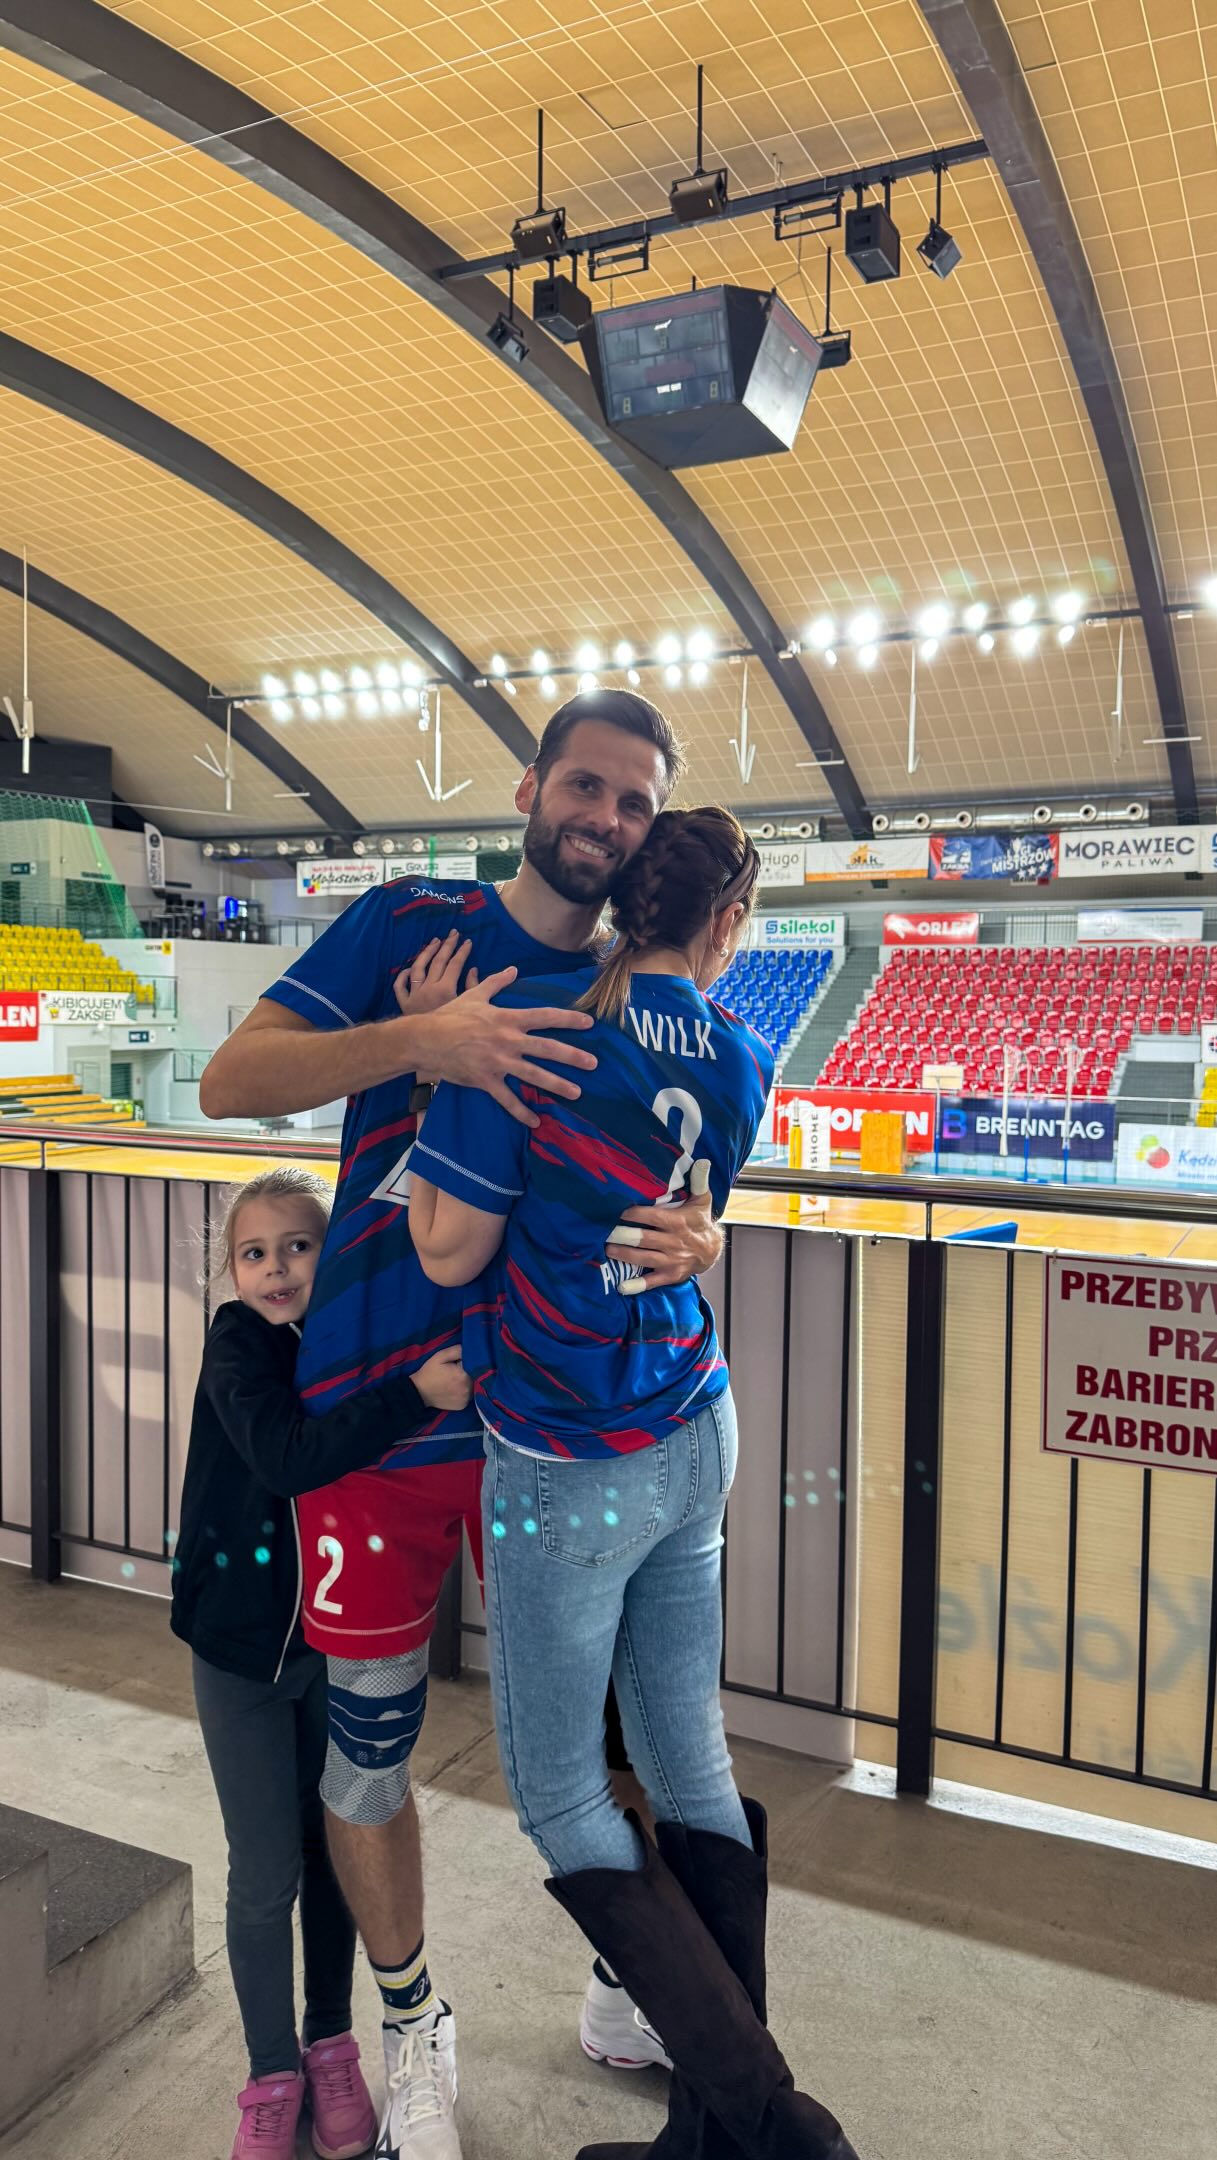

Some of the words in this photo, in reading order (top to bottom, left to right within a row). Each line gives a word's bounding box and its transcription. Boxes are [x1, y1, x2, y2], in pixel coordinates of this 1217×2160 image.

[762, 852, 800, 868] Hugo
[1065, 837, 1195, 860] MORAWIEC
[1101, 857, 1174, 869] PALIWA
[767, 936, 803, 944] Solutions
[819, 937, 834, 945] you
[780, 919, 835, 934] silekol
[628, 1006, 717, 1061] WILK
[830, 1107, 930, 1136] ORN
[975, 1116, 1106, 1140] BRENNTAG
[652, 1087, 702, 1209] 2
[1061, 1269, 1217, 1315] PRZEBY
[1076, 1364, 1215, 1412] BARIER
[1065, 1409, 1217, 1461] ZABRON
[313, 1535, 344, 1615] 2
